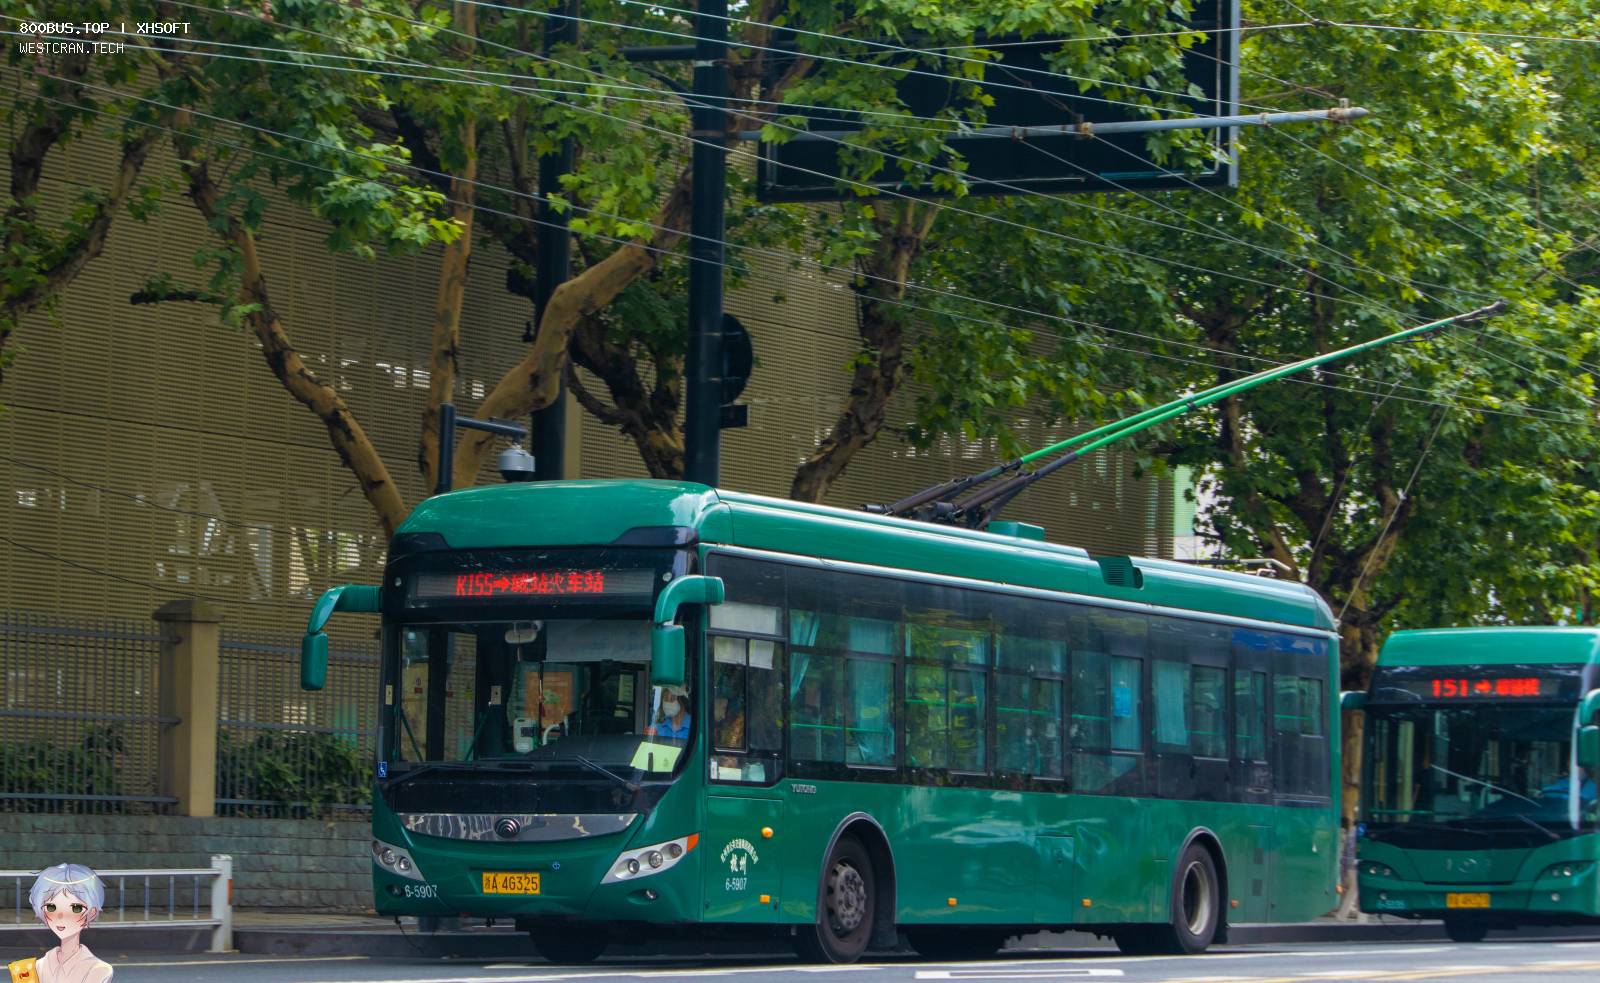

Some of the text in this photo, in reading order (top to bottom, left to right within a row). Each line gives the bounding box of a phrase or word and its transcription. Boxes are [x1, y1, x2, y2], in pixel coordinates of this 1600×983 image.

[1432, 679, 1468, 698] 151
[404, 884, 437, 898] 6-5907
[725, 877, 747, 891] 6-5907
